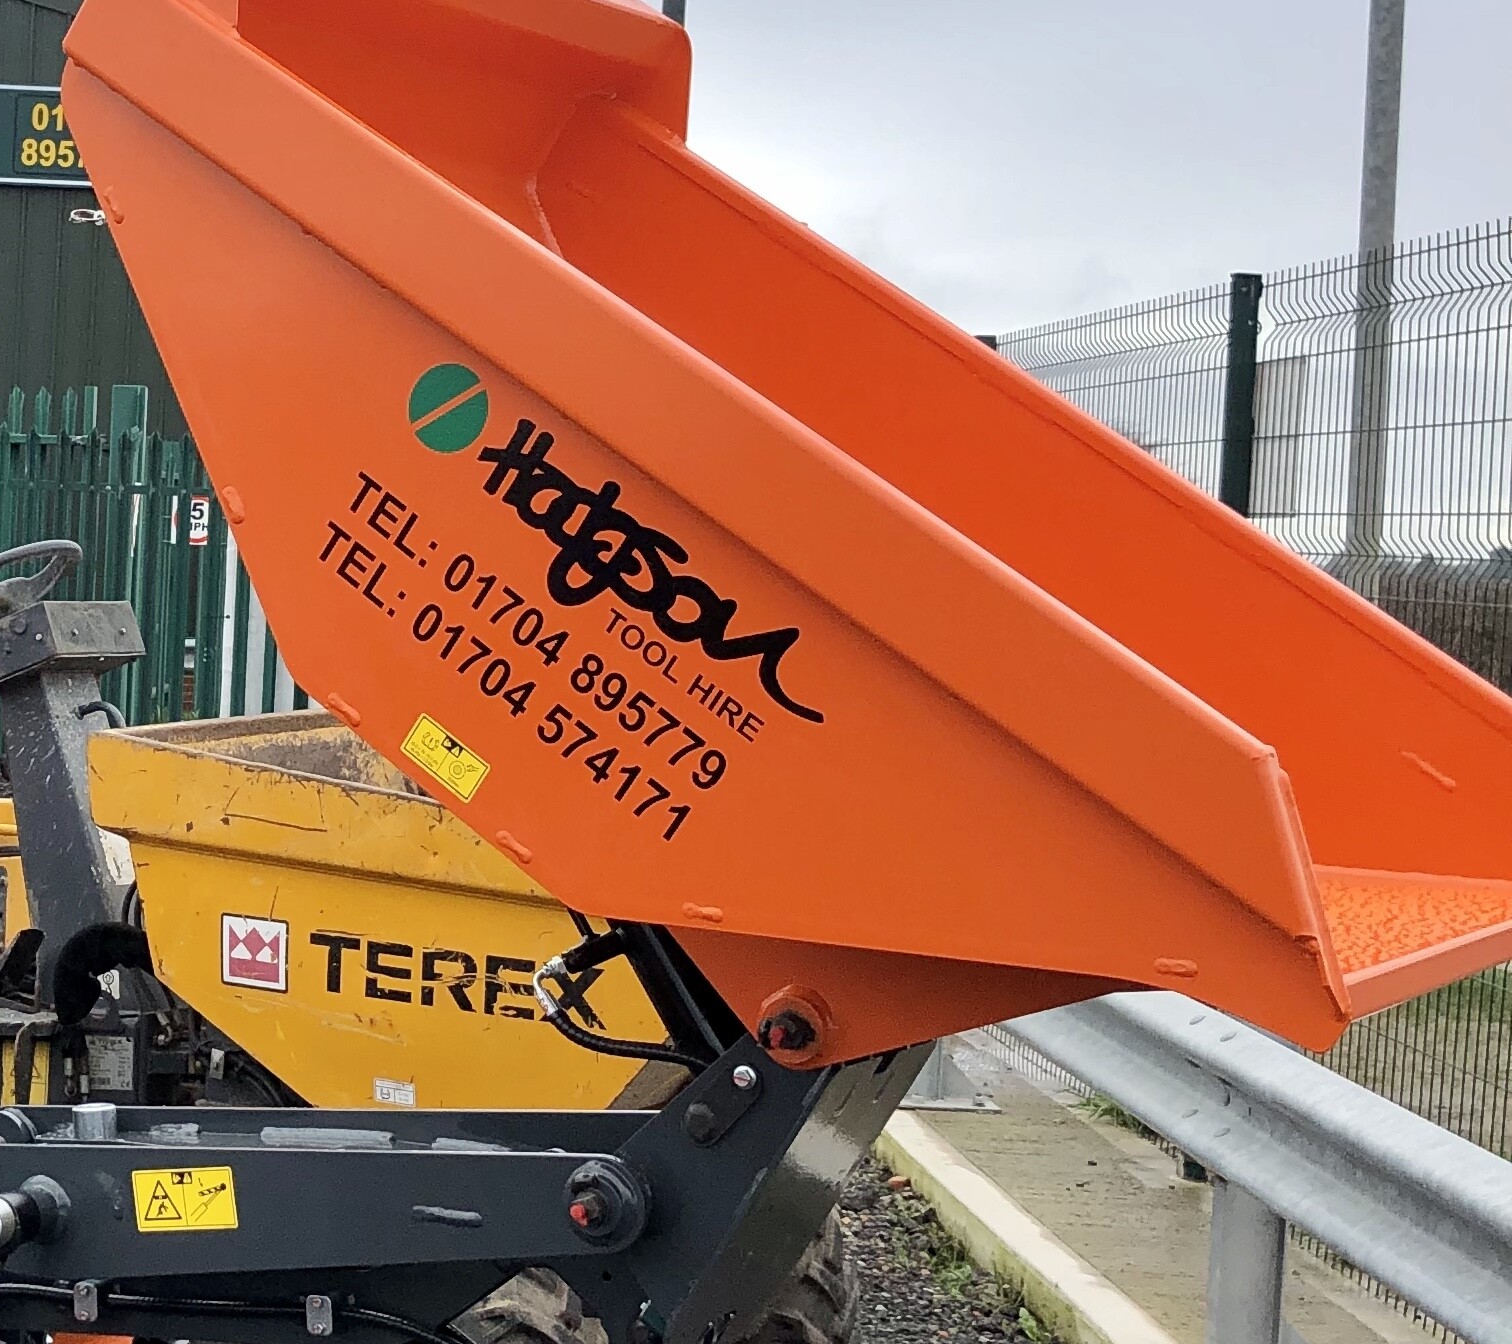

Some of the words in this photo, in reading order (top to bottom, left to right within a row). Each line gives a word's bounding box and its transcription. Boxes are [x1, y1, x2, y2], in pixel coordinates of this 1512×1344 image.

[20, 138, 84, 168] 895
[31, 102, 65, 132] 01
[190, 502, 205, 521] 5
[349, 470, 438, 568] TEL:
[444, 553, 570, 667] 01704
[569, 653, 728, 790] 895779
[476, 418, 825, 724] Hodgson
[318, 519, 407, 618] TEL:
[412, 603, 536, 718] 01704
[536, 703, 692, 842] 574171
[605, 607, 679, 685] TOOL
[686, 673, 766, 743] HIRE
[309, 931, 608, 1031] TEREX
